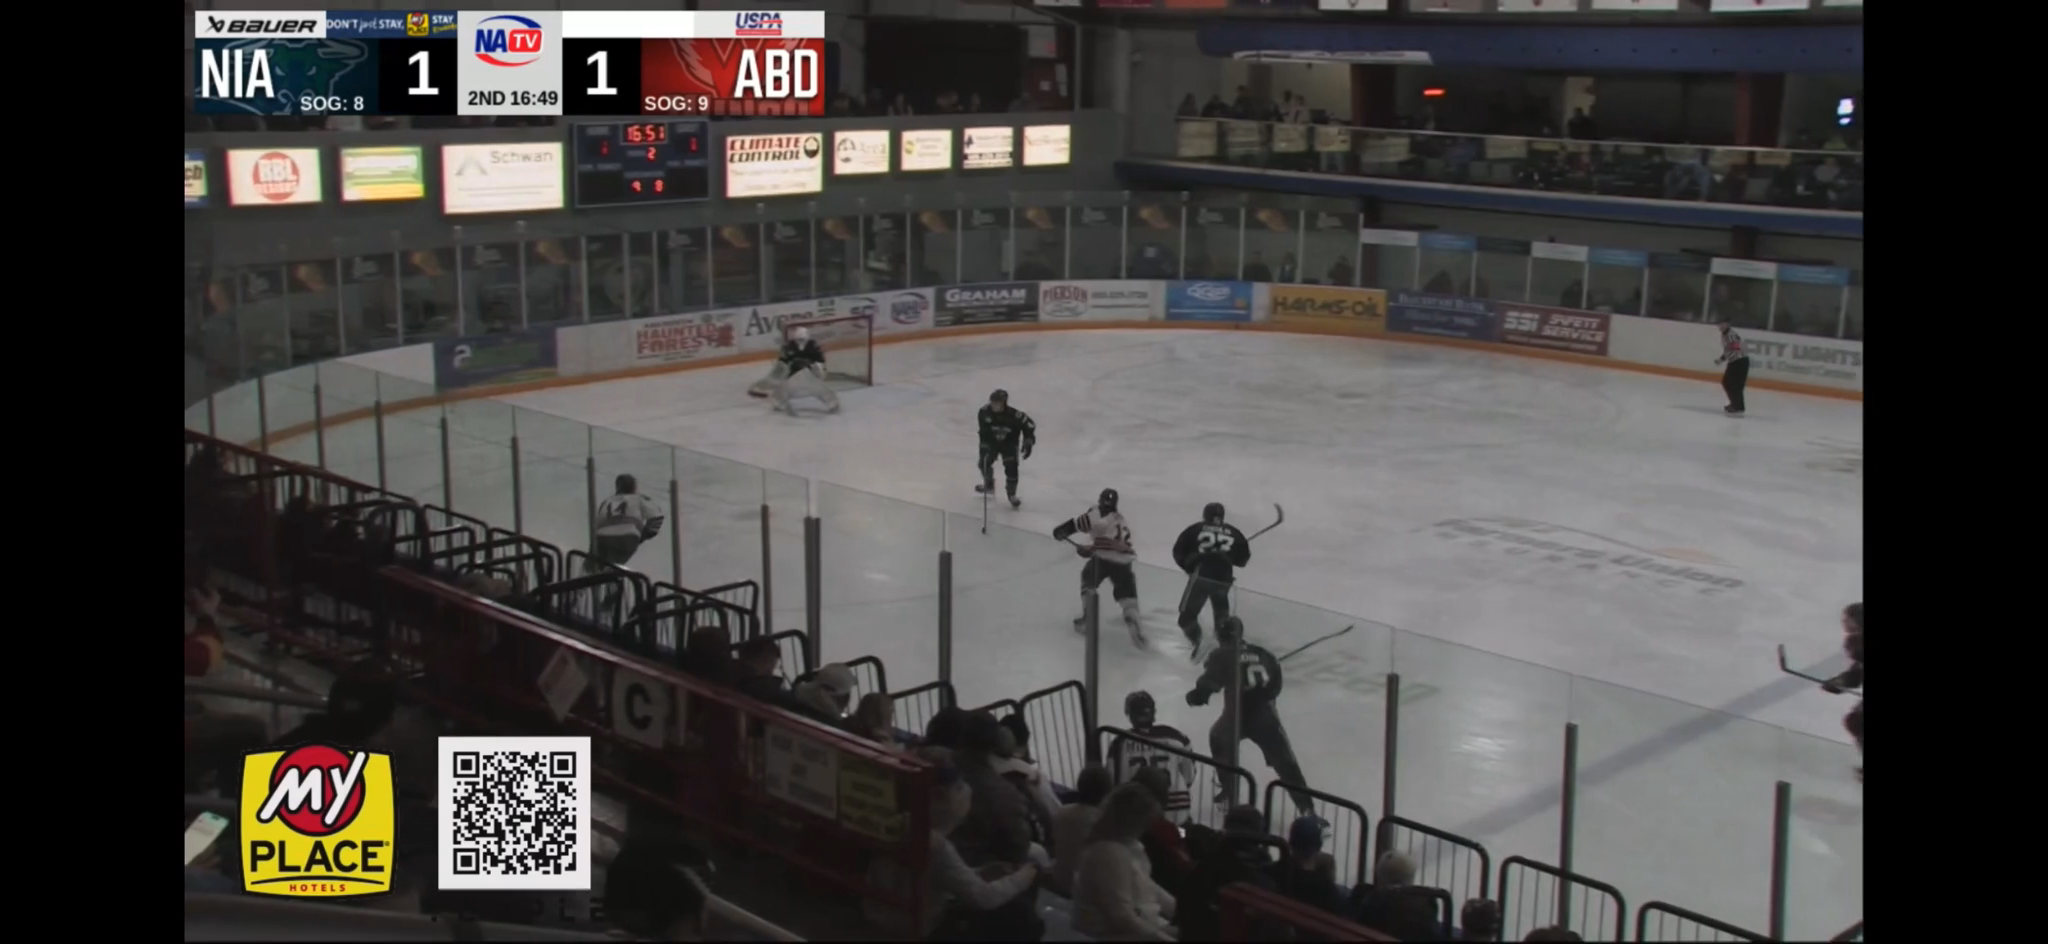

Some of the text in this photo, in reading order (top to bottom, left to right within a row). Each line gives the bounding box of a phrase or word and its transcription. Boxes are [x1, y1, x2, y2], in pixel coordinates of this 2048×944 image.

[729, 136, 801, 151] CLIMATE
[489, 150, 553, 164] Schwan
[646, 146, 657, 161] 2
[944, 287, 1028, 302] GRAHAM
[636, 324, 717, 341] HAUNTED
[636, 336, 714, 354] FOREST
[626, 682, 653, 731] C
